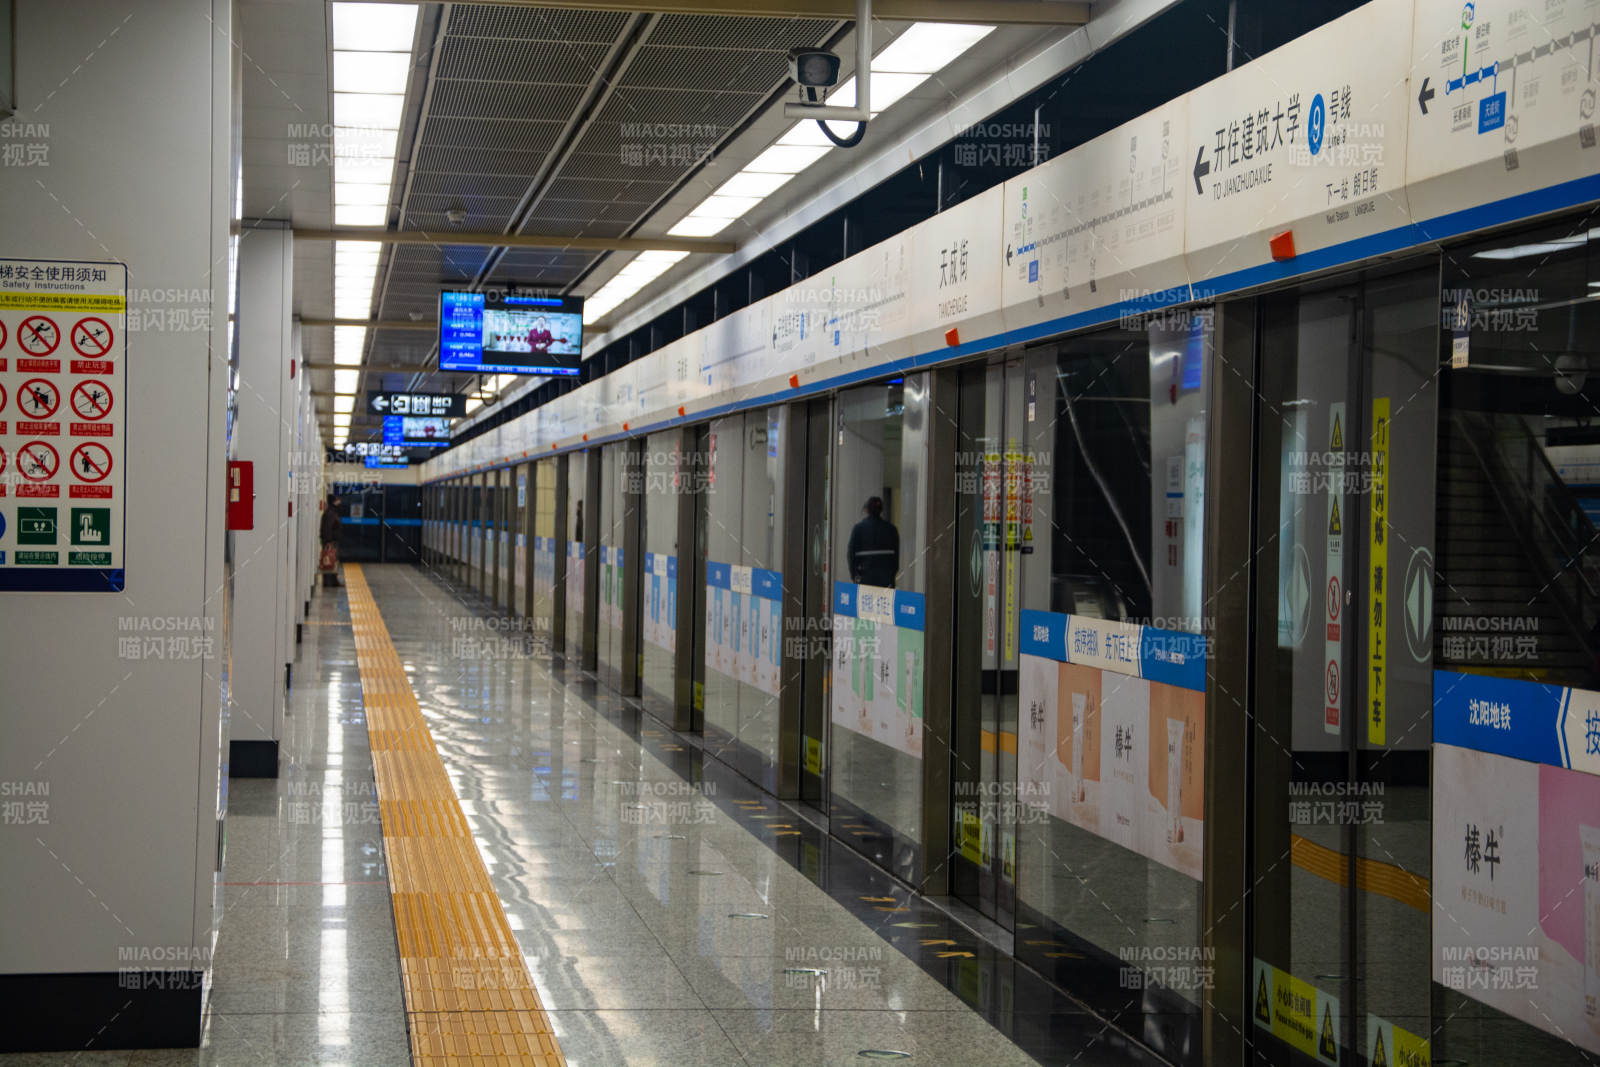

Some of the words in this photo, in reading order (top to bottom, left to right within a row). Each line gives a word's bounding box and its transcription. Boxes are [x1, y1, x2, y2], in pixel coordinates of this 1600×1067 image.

[1214, 92, 1300, 173] 开往建筑大学
[1311, 105, 1322, 144] 9
[1329, 84, 1351, 125] 号线
[1213, 181, 1222, 201] TO
[1223, 163, 1273, 198] JIANZHUDAXUE
[1326, 175, 1349, 206] 下一站
[0, 264, 107, 282] 梯安全使用须知
[938, 238, 969, 289] 天成街
[2, 280, 31, 290] Safety
[35, 281, 86, 291] Instructions
[1456, 300, 1469, 327] 19
[1372, 566, 1384, 728] 请勿上下车
[1469, 699, 1512, 731] 沈阳地铁
